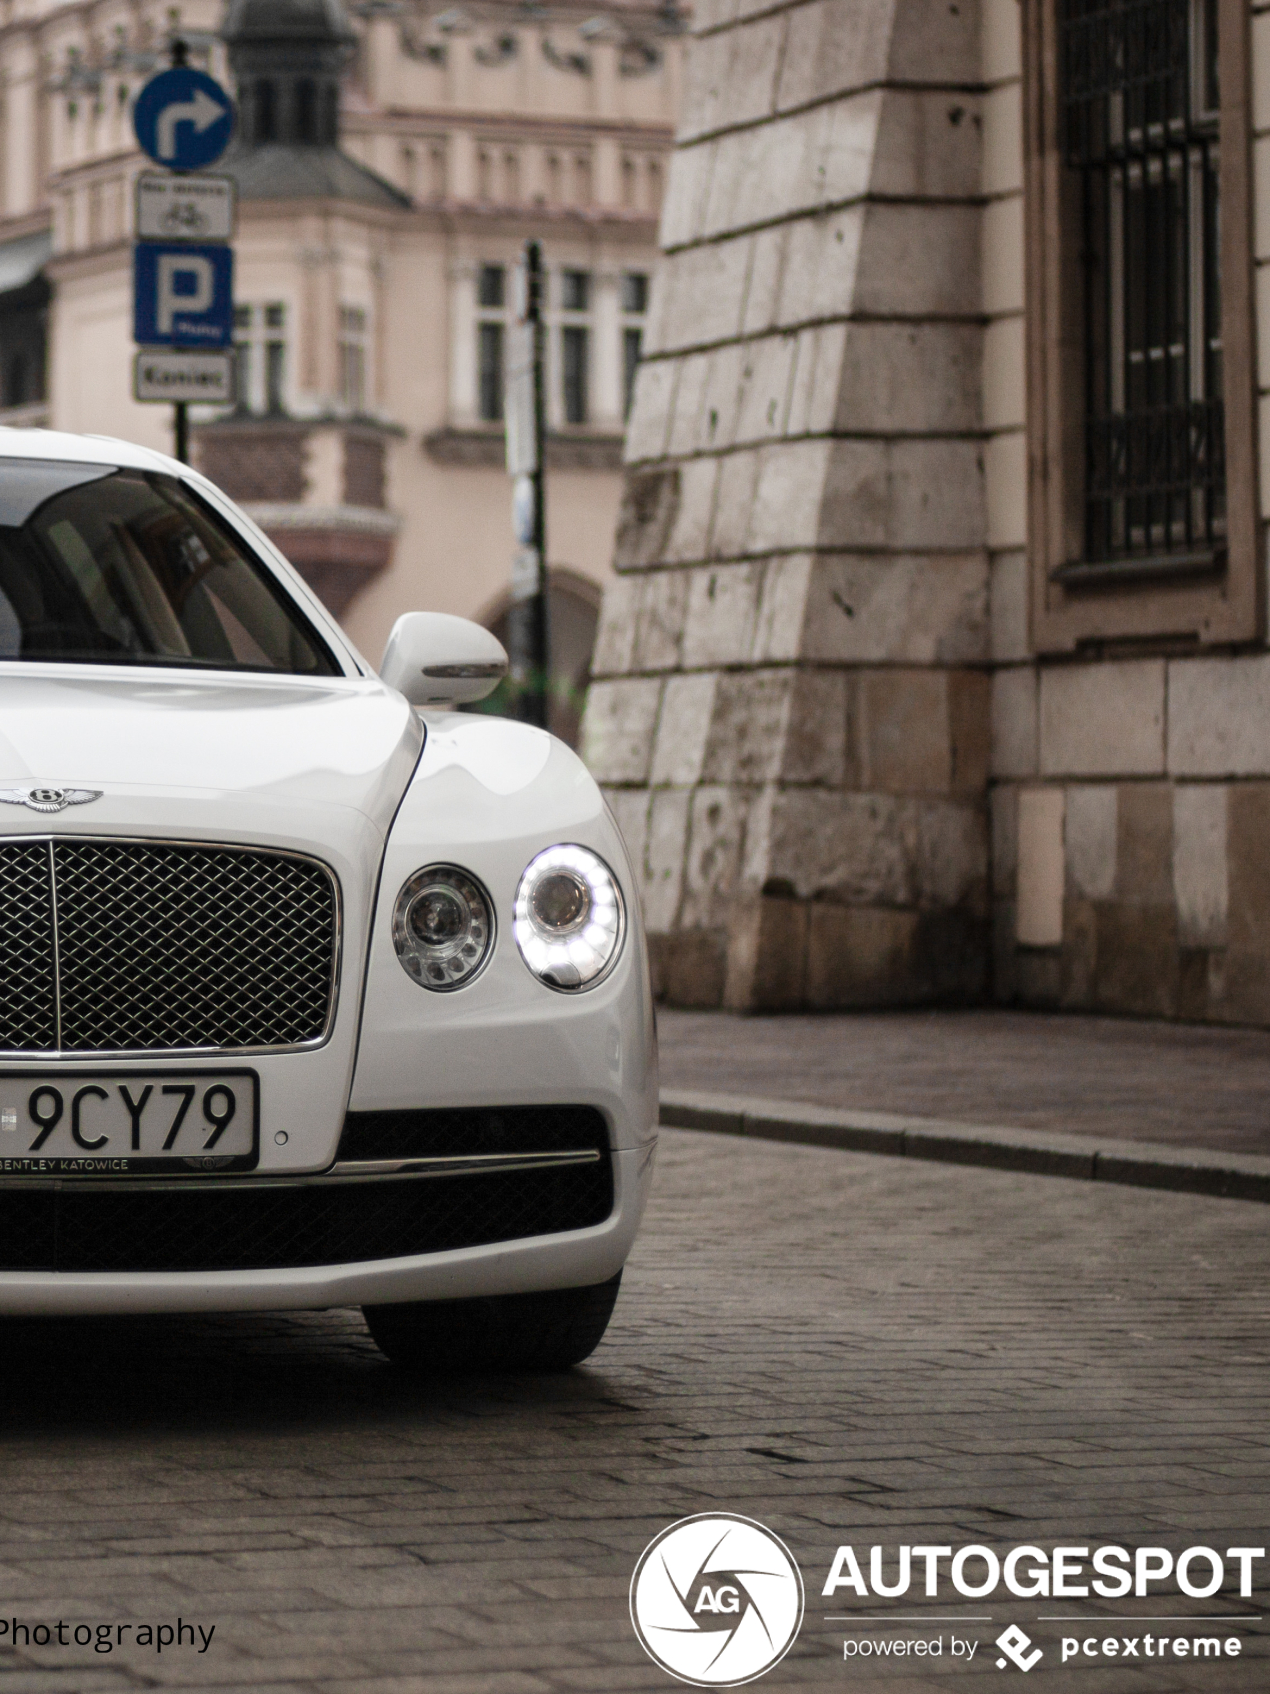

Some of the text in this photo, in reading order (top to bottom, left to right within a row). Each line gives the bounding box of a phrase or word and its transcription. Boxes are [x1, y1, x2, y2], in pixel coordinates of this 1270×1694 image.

[156, 254, 214, 335] P
[28, 1083, 237, 1151] 9CY79
[60, 1159, 129, 1171] KATOWICE
